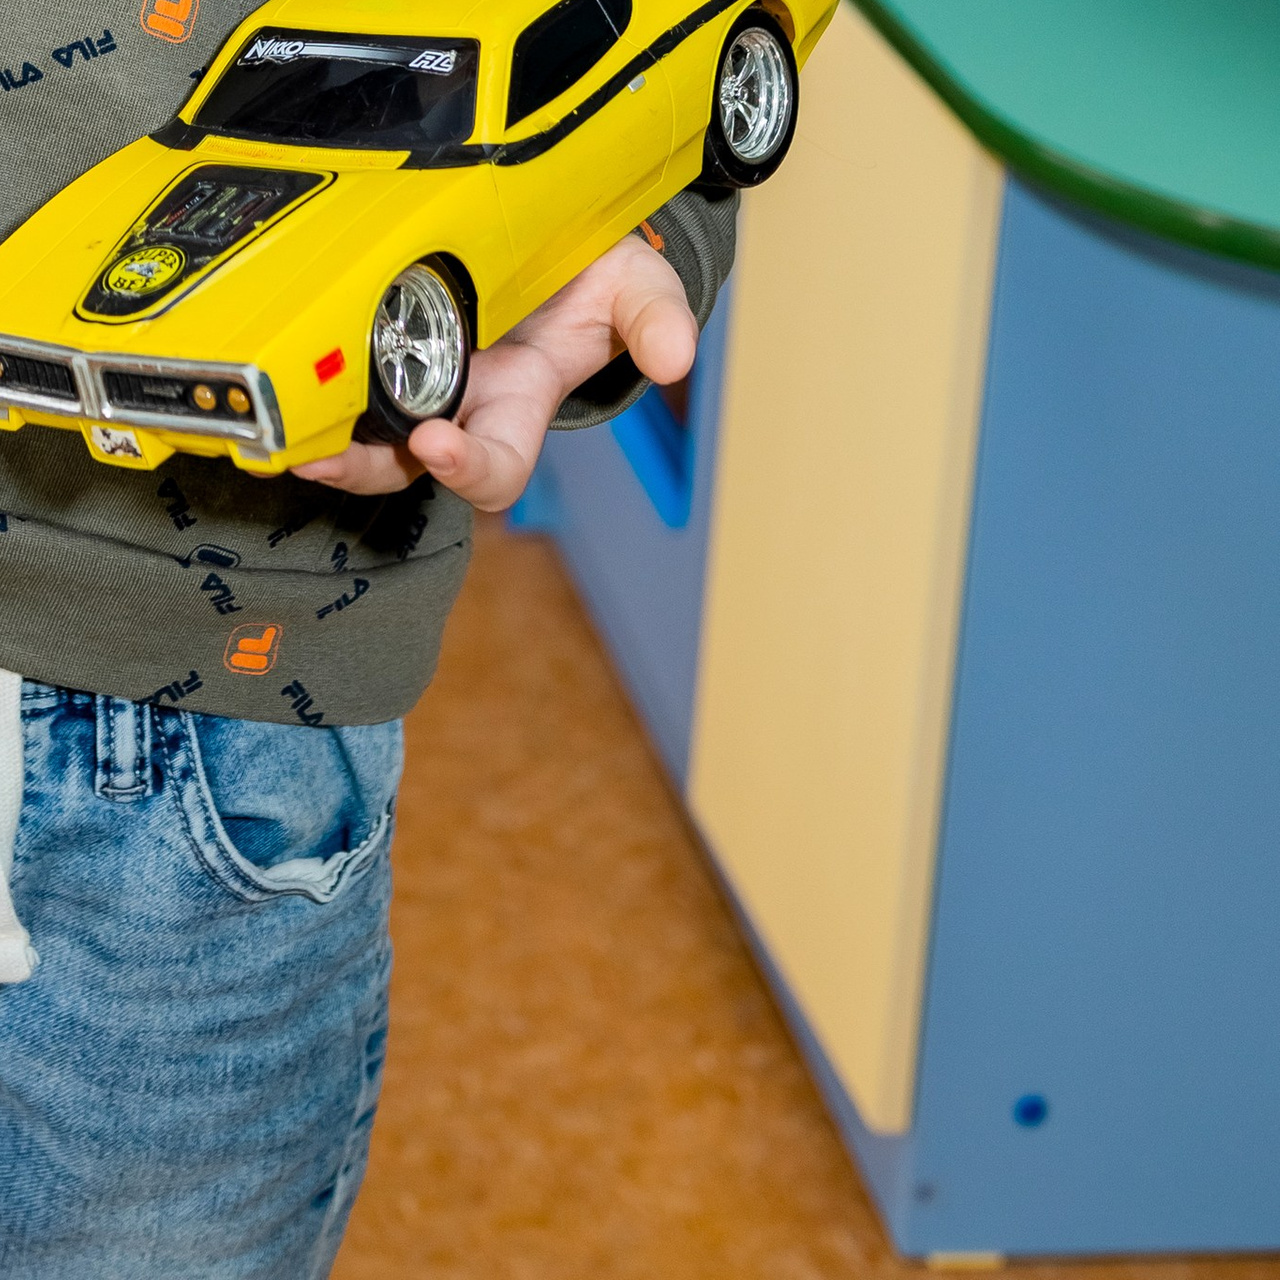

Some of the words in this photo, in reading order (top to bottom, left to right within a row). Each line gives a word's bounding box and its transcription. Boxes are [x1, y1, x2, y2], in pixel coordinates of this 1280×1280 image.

[52, 30, 118, 70] FILA
[243, 37, 306, 60] NIKKO
[200, 571, 244, 616] FILA
[316, 577, 372, 621] FILA
